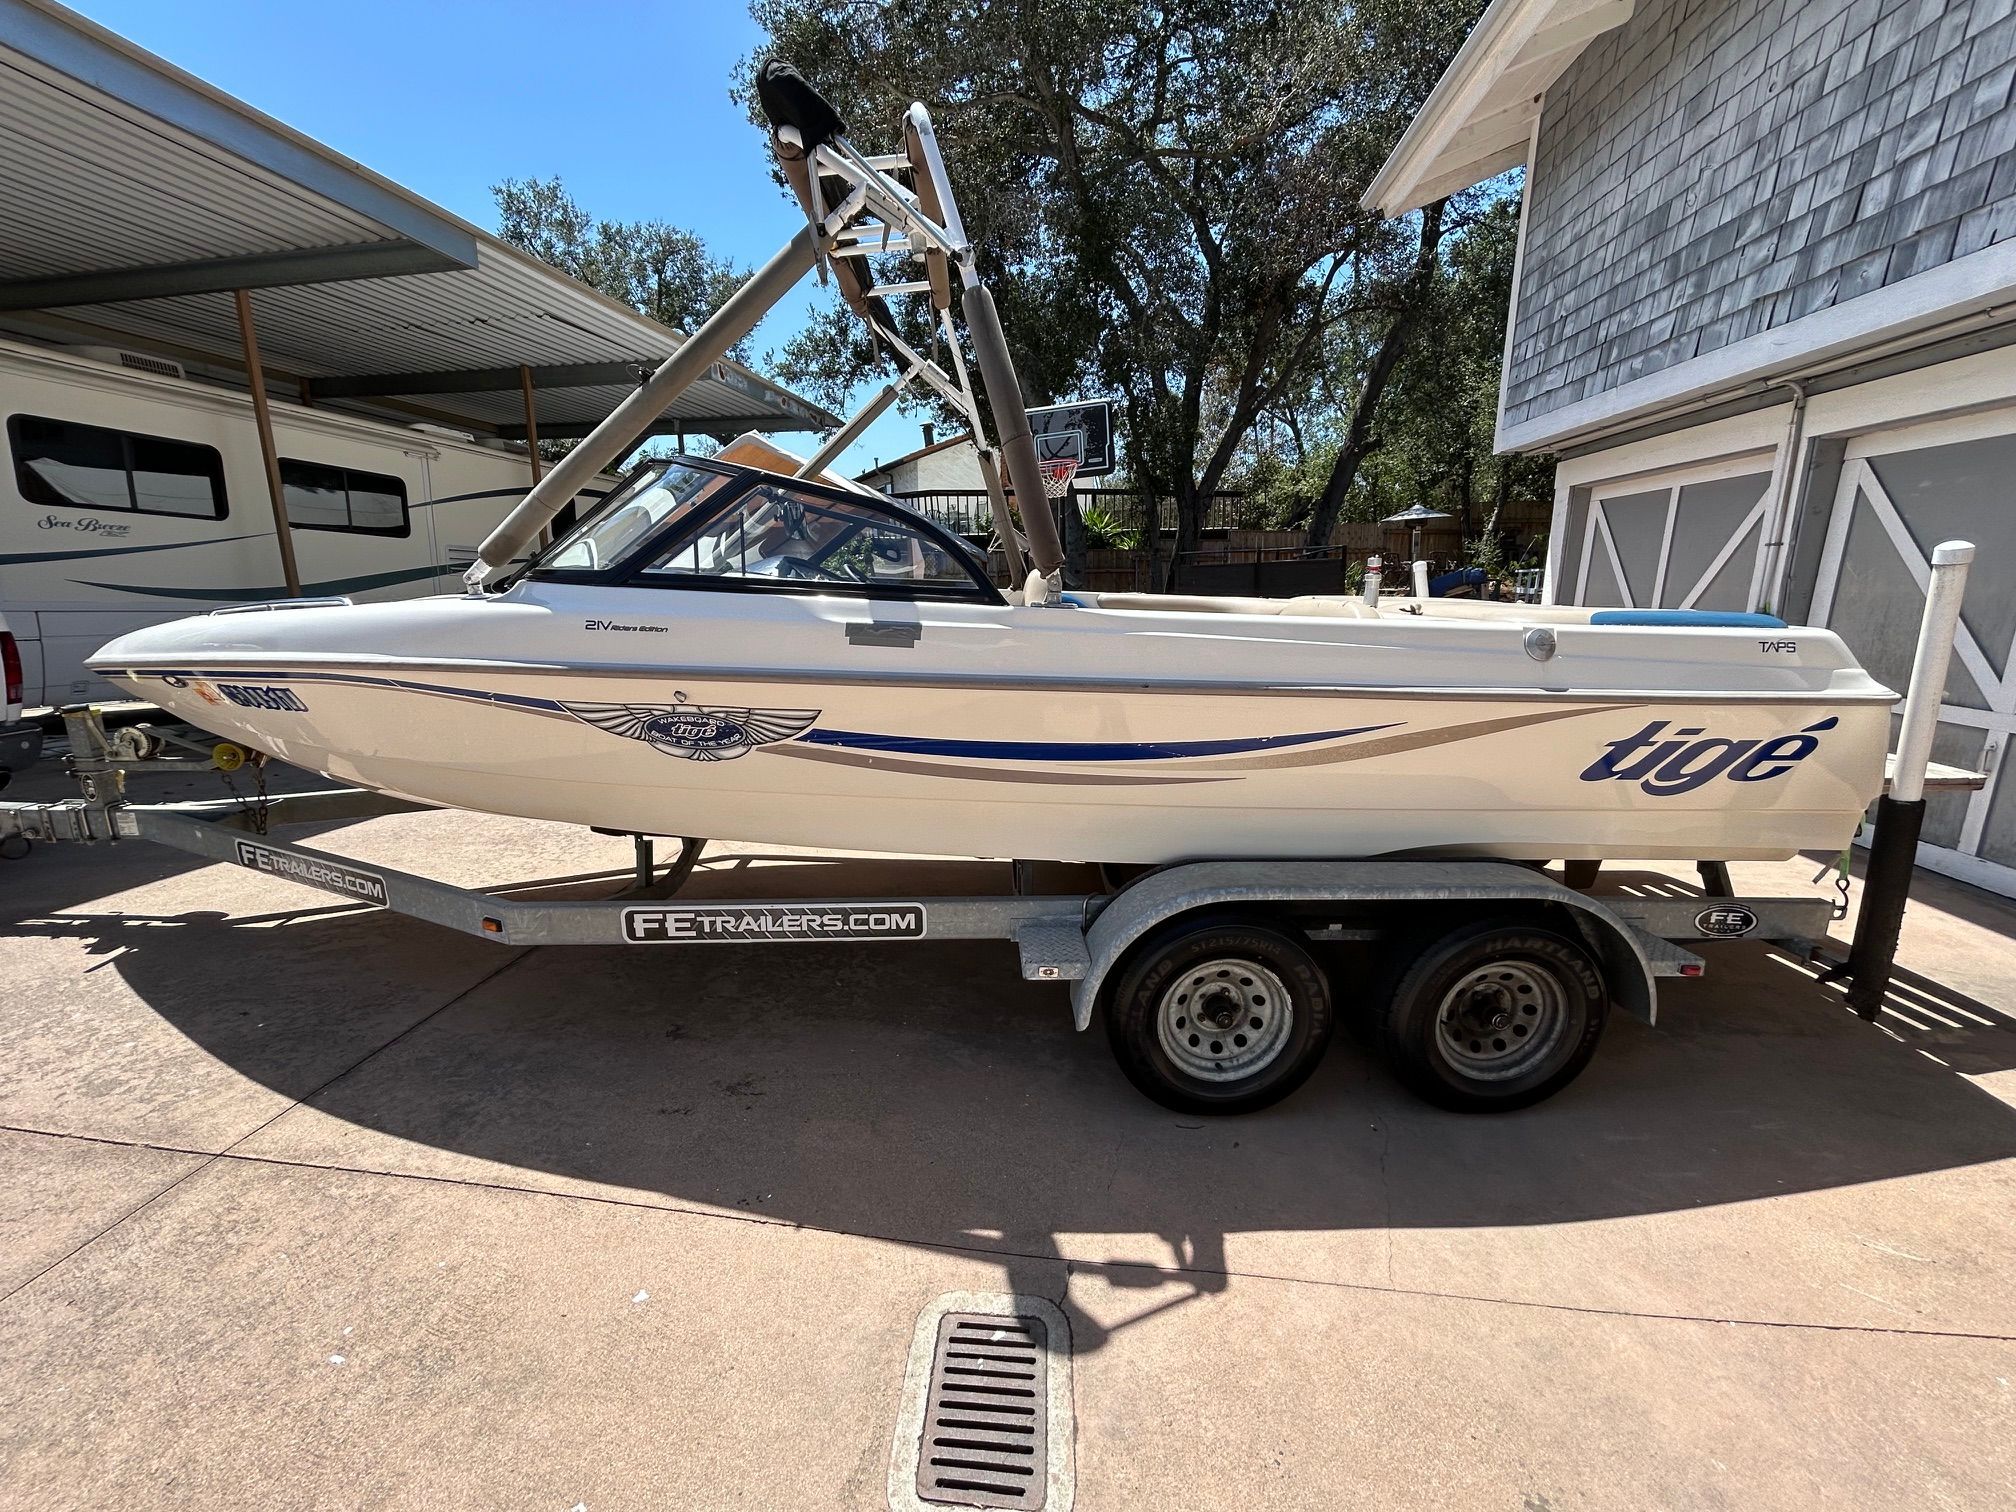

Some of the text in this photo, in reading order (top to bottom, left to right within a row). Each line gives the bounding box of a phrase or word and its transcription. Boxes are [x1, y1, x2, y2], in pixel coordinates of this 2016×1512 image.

[37, 514, 132, 532] Sea Breeze
[610, 624, 638, 632] Riders
[638, 625, 669, 633] Edition
[1758, 641, 1796, 653] TAPS
[657, 716, 725, 727] WAKEBOARD
[651, 730, 678, 744] BOAT
[698, 739, 718, 747] THE
[718, 733, 742, 746] YEAR
[671, 723, 717, 739] tigé
[1579, 716, 1839, 796] tigé
[1710, 912, 1744, 924] FE
[1486, 937, 1601, 1001] HARTLAND
